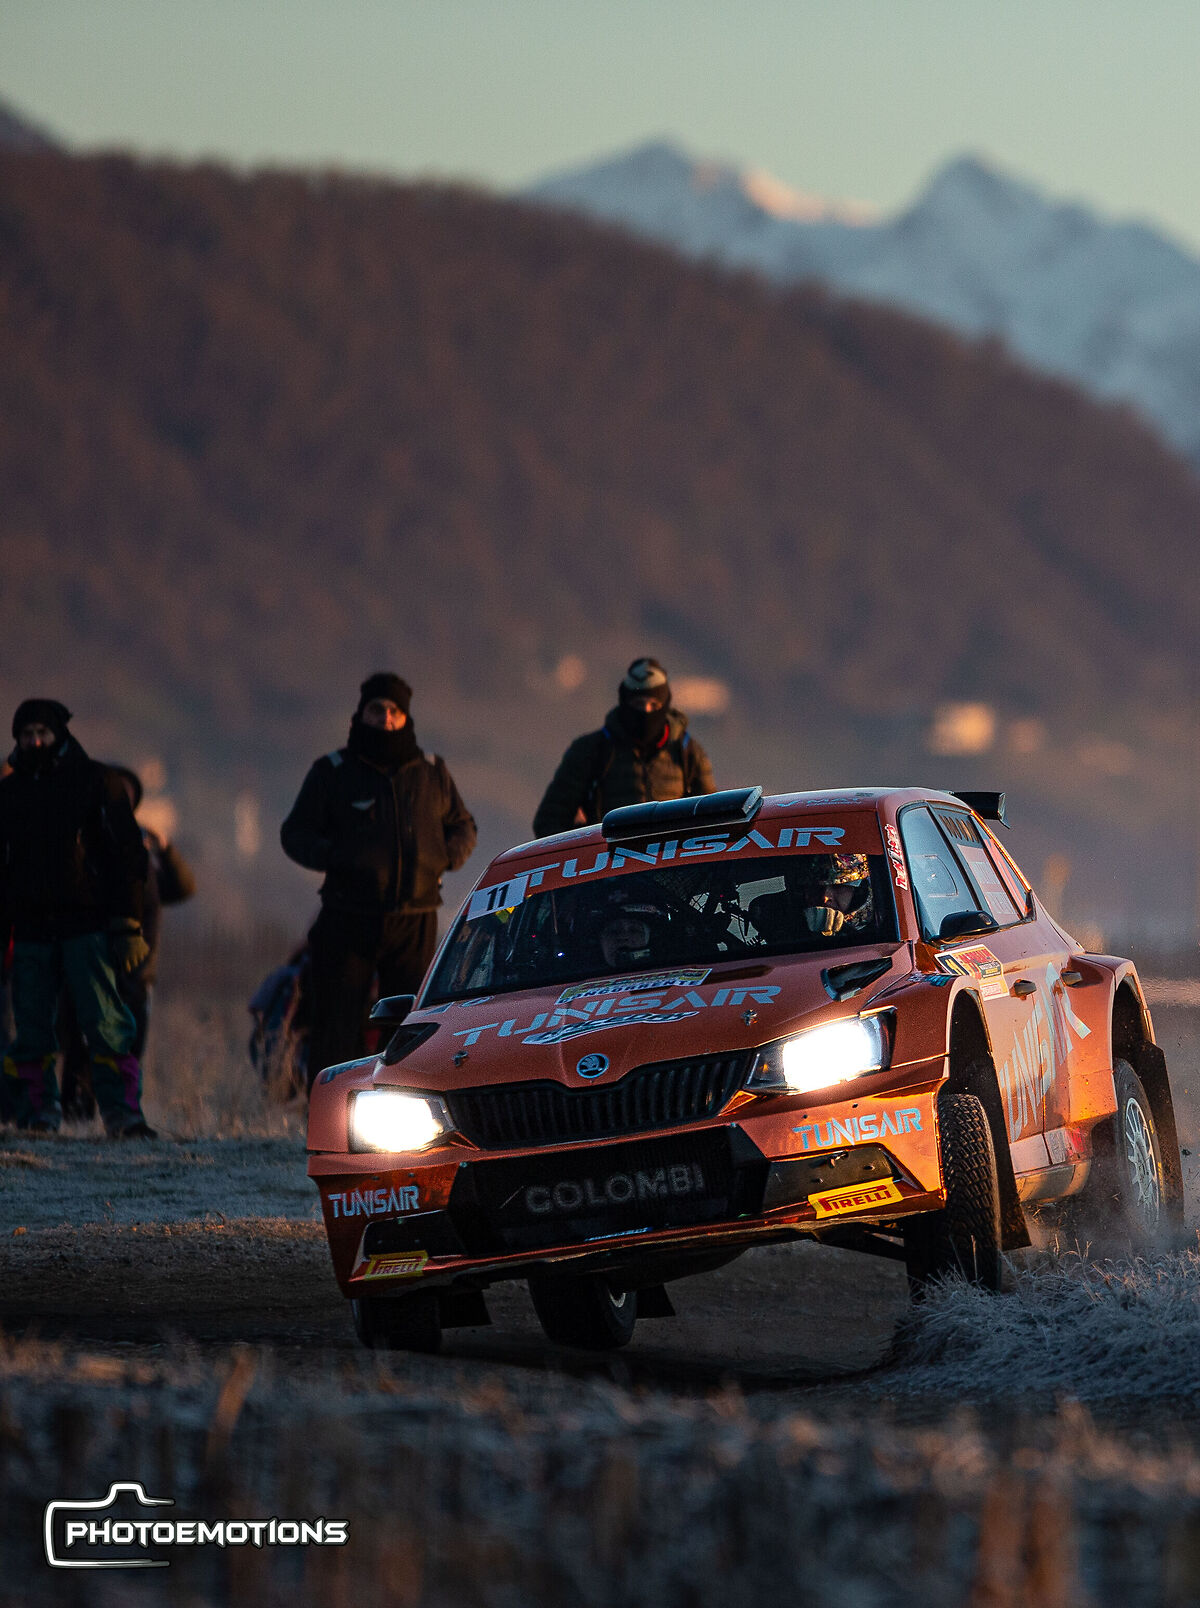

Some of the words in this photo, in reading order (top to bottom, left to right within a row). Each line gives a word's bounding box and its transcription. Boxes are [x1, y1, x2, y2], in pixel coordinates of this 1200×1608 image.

[514, 826, 846, 888] TUNISAIR
[486, 883, 511, 911] 11
[453, 985, 782, 1047] TUNISAIR
[793, 1107, 923, 1150] TUNISAIR
[328, 1184, 420, 1219] TUNISAIR
[524, 1162, 706, 1214] COLOMBI
[821, 1185, 893, 1212] PIRELLI
[370, 1255, 423, 1275] PIRELLI
